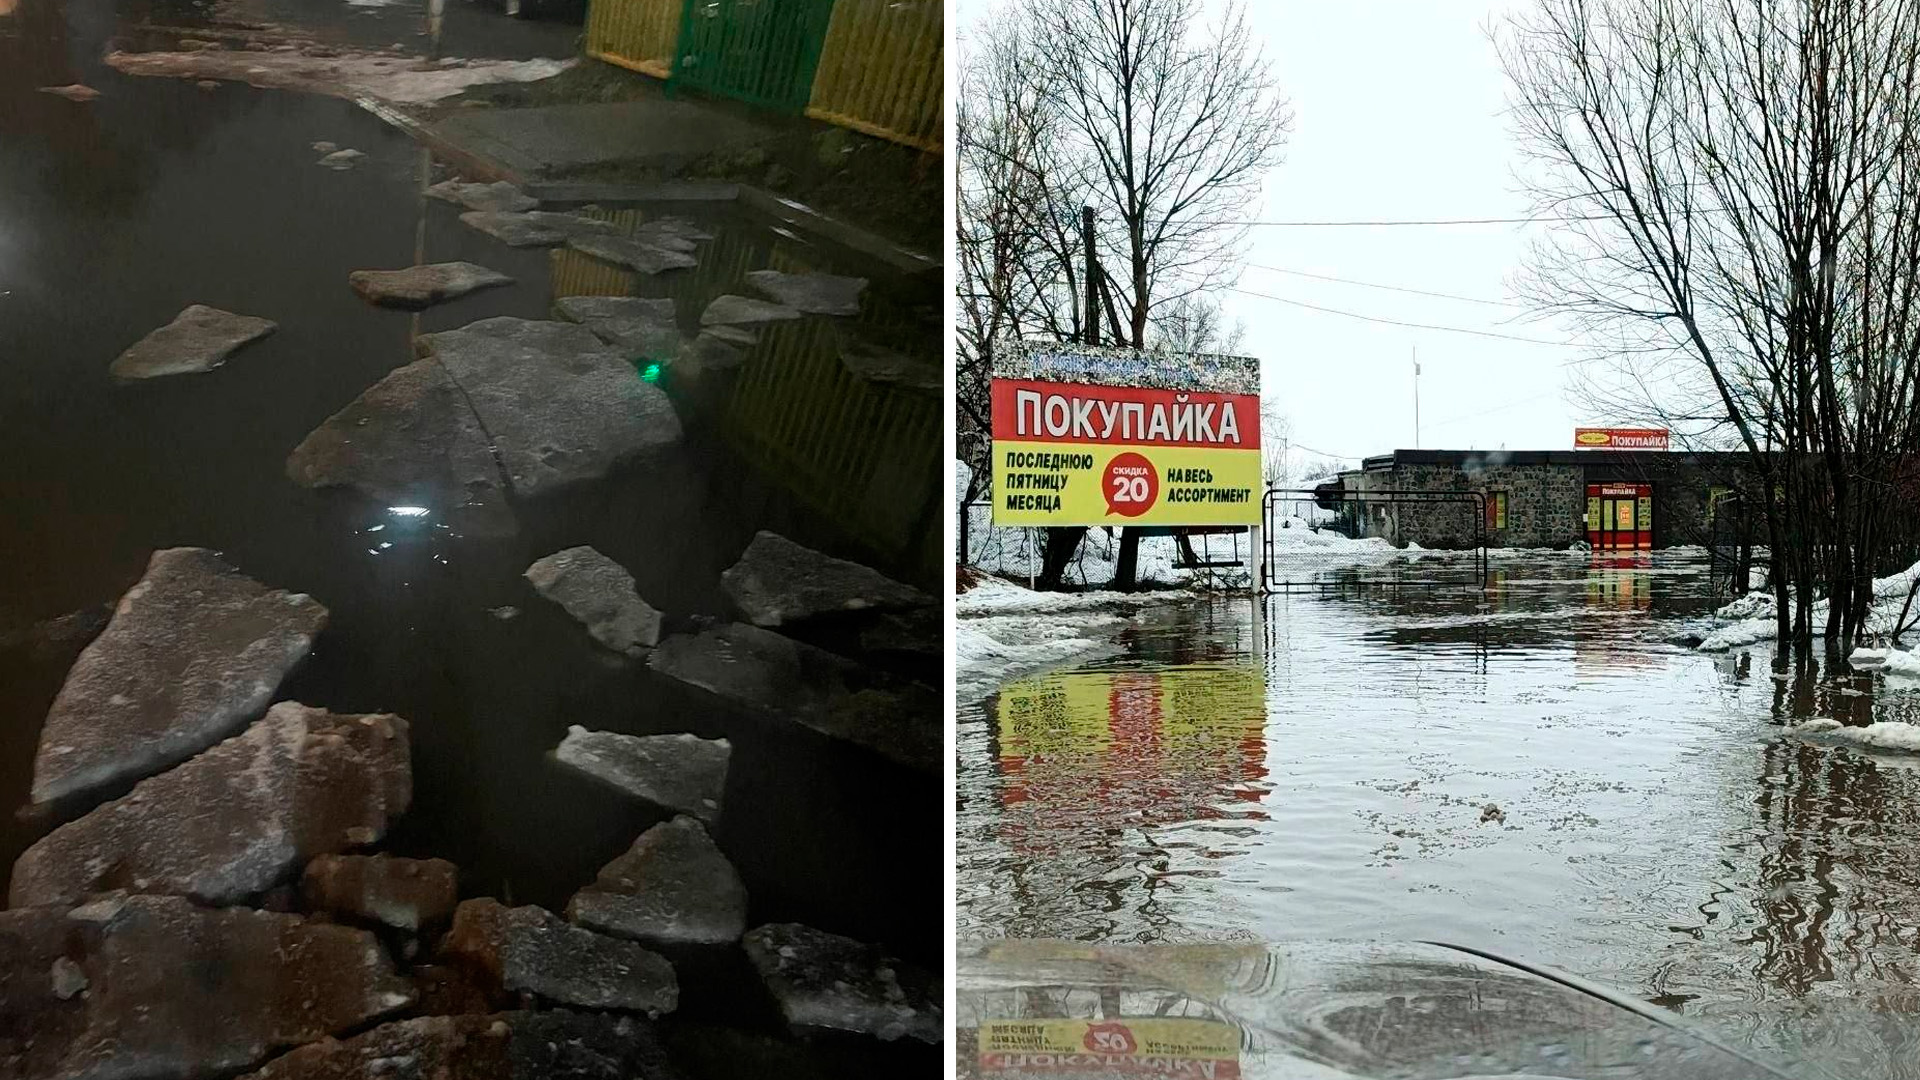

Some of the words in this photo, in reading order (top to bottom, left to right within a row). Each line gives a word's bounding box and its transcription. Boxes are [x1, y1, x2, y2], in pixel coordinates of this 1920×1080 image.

[1016, 388, 1241, 443] ПОКУПАЙКА
[1612, 437, 1667, 446] ПОКУПАЙКА
[1006, 452, 1093, 470] ПОСЛЕДНЮЮ
[1113, 467, 1149, 476] СКИДКА
[1167, 468, 1184, 483] НА
[1185, 469, 1213, 484] ВЕСЬ
[1006, 473, 1068, 490] ПЯТНИЦУ
[1113, 477, 1149, 502] 20
[1006, 495, 1061, 513] МЕСЯЦА
[1168, 488, 1251, 503] АССОРТИМЕНТ
